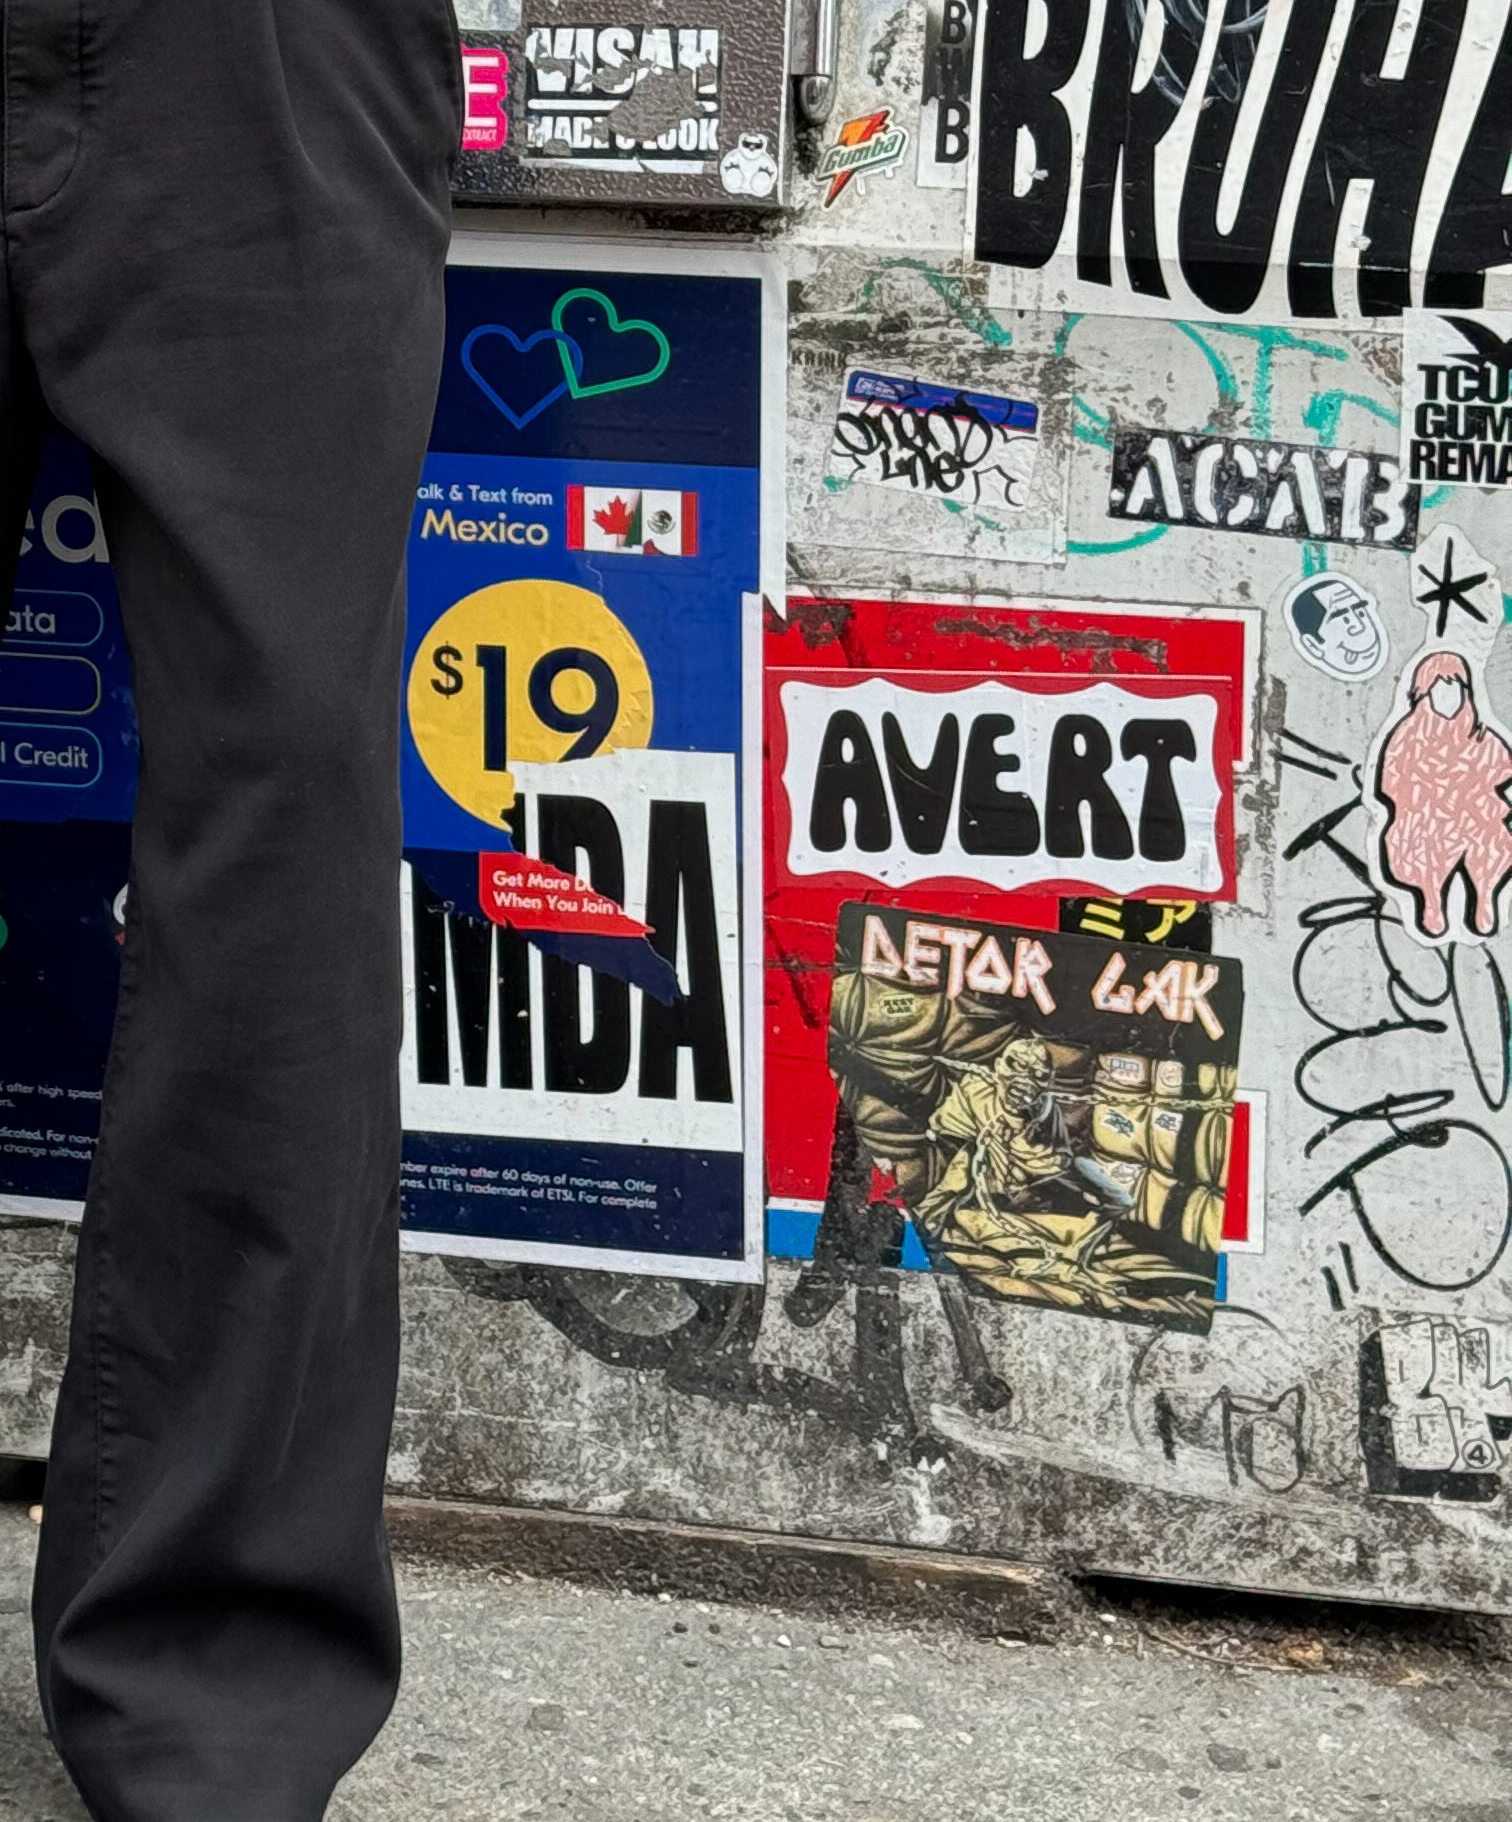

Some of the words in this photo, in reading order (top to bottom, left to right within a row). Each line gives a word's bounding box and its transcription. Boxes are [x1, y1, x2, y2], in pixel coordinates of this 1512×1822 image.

[824, 133, 902, 173] Gumba
[415, 483, 445, 502] alk
[448, 484, 465, 503] &
[468, 485, 508, 505] Text
[510, 487, 555, 507] from
[1124, 434, 1409, 544] ACAB
[420, 508, 550, 547] Mexico
[4, 604, 58, 635] ata
[13, 742, 90, 769] Credit
[808, 708, 1197, 863] AVERT
[492, 870, 524, 888] Get
[526, 872, 571, 892] More
[492, 890, 543, 910] When
[545, 894, 578, 913] You
[581, 898, 614, 915] Join
[37, 1084, 65, 1099] high
[66, 1088, 104, 1101] speed
[46, 1129, 67, 1143] For
[3, 1143, 48, 1158] change
[48, 1145, 93, 1161] without
[430, 1165, 468, 1179] expire
[469, 1167, 500, 1179] after
[501, 1169, 519, 1181] 60
[520, 1171, 551, 1185] days
[553, 1173, 568, 1185] of
[623, 1178, 658, 1194] Offer
[428, 1178, 451, 1192] LTE
[452, 1180, 464, 1193] is
[465, 1182, 528, 1198] trademark
[530, 1187, 545, 1199] of
[578, 1190, 599, 1204] For
[600, 1194, 658, 1210] complete
